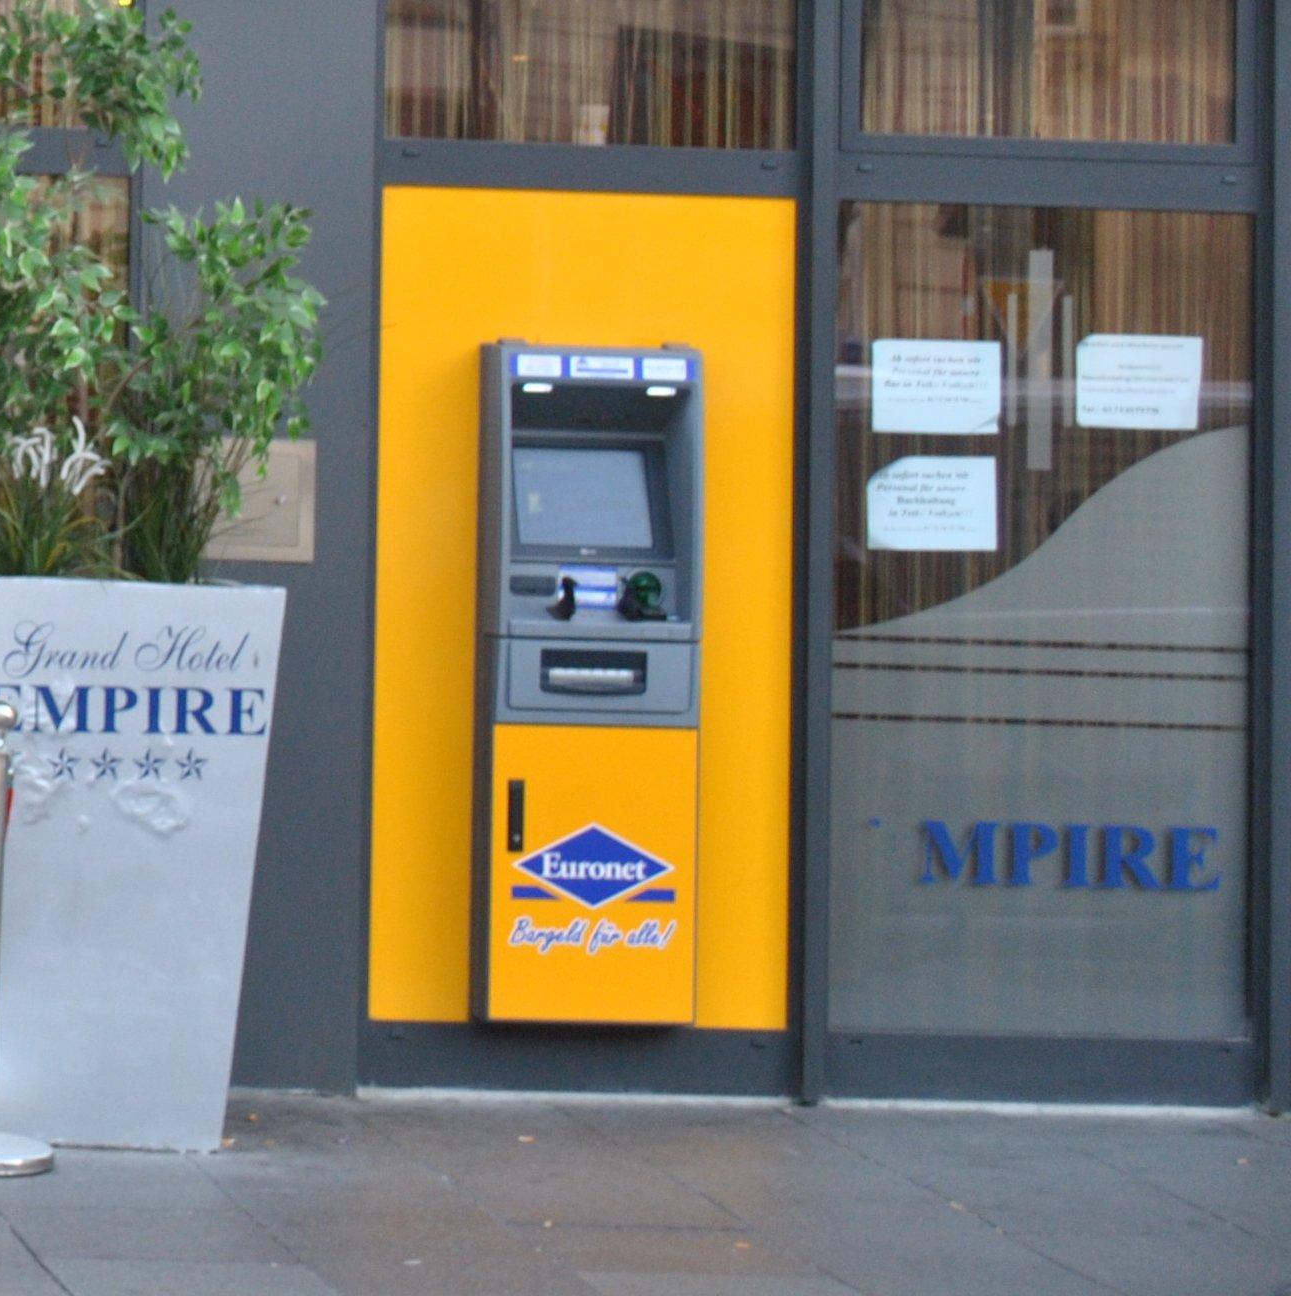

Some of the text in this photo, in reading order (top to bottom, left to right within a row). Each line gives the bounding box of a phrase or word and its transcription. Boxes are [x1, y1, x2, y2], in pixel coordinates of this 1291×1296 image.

[2, 620, 251, 679] Grand Hotel
[540, 851, 648, 882] Euronet
[918, 820, 1221, 891] MPIRE
[509, 916, 677, 954] Bargeld für alle!
